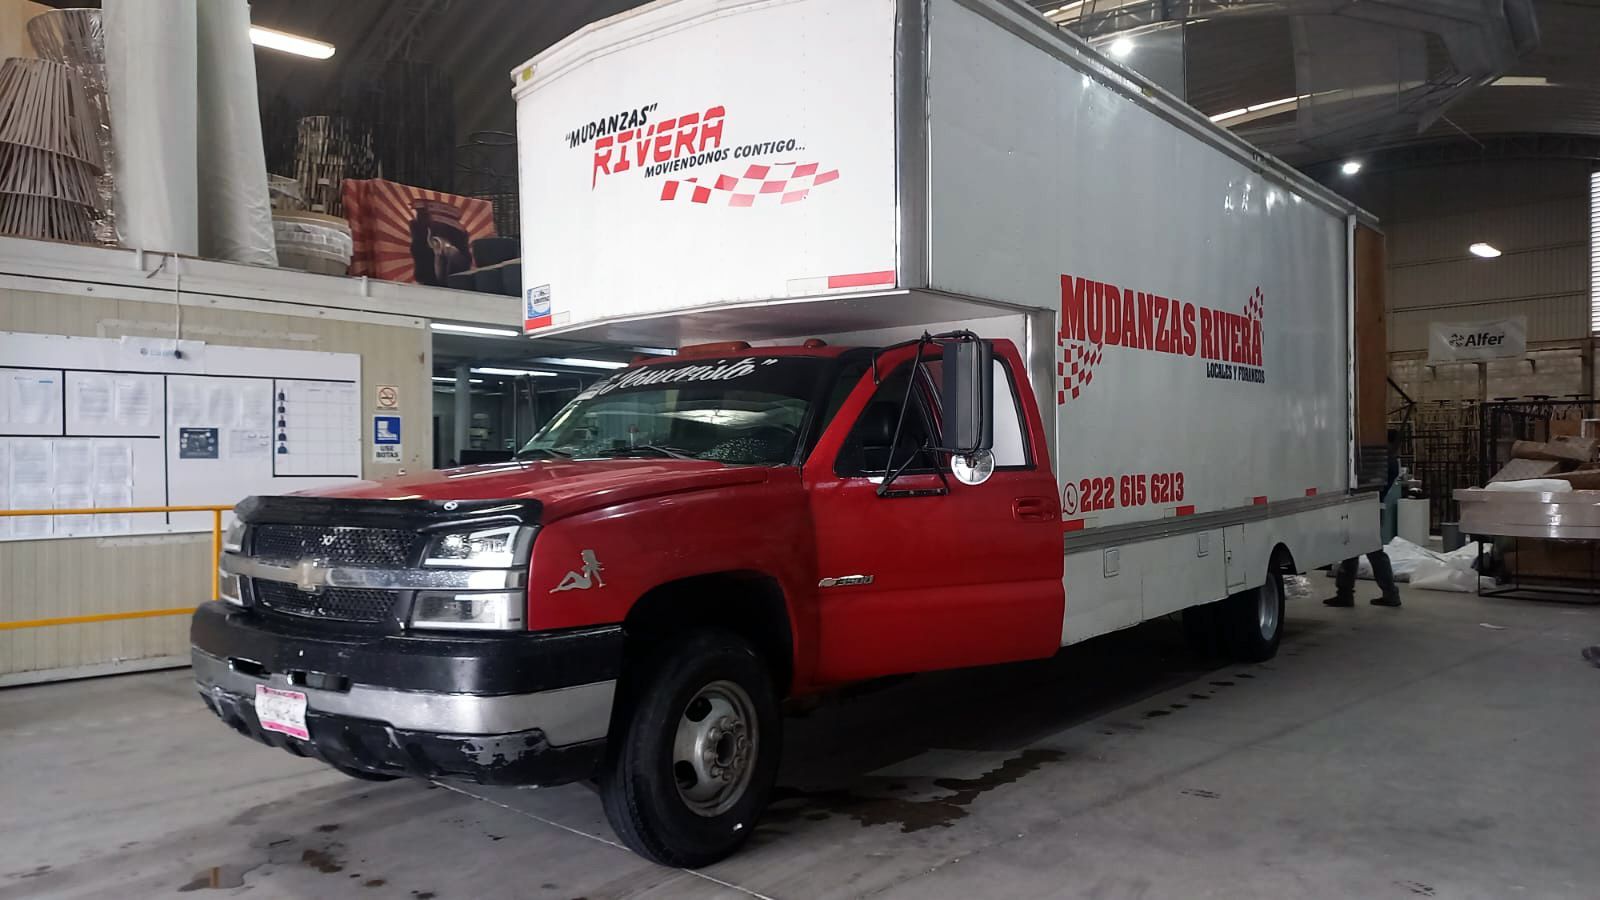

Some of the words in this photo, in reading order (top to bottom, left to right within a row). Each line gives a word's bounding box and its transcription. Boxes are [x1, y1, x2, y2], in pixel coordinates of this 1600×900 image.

[592, 105, 725, 190] RIVERA
[644, 149, 730, 178] MOVIENDONOS
[734, 138, 806, 159] CONTIGO...
[1060, 274, 1196, 357] MUDANZAS
[1200, 307, 1263, 366] RIVERA
[1465, 332, 1504, 347] Alfer
[1206, 362, 1232, 379] LOCALES
[1232, 366, 1238, 380] Y
[1239, 366, 1265, 383] FORANEOS
[1079, 477, 1115, 512] 222
[1120, 473, 1146, 508] 615
[1151, 472, 1184, 504] 6213
